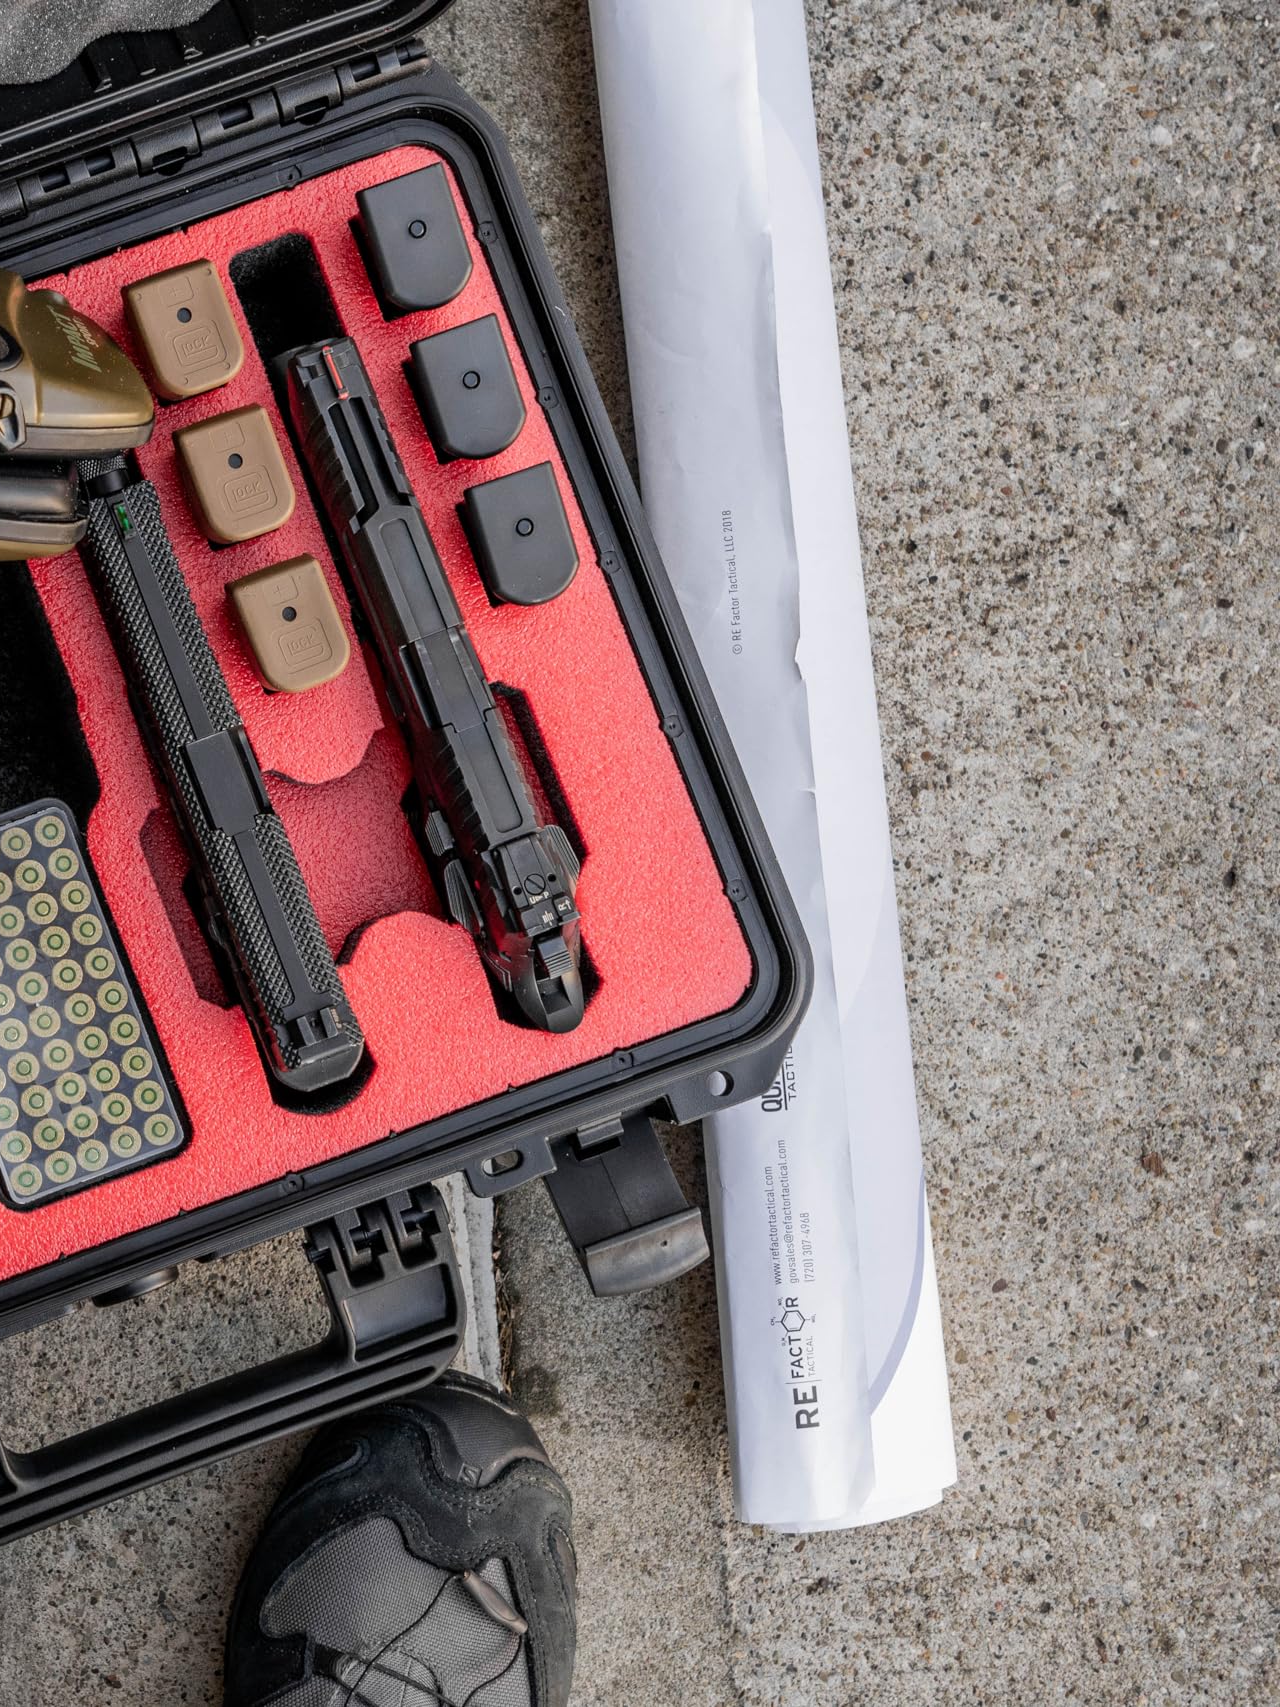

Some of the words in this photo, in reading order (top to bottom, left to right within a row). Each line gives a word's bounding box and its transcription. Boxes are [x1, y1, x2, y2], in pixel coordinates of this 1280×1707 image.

[46, 304, 102, 373] IMPACT
[721, 510, 733, 533] 2018
[723, 535, 735, 552] LLC
[725, 554, 738, 594] Tactical,
[730, 597, 741, 626] Factor
[731, 628, 742, 641] RE
[763, 1166, 783, 1286] www.refactortactical.com
[777, 1139, 799, 1284] govsales@refactortactical.com
[799, 1212, 813, 1256] 307-4968
[802, 1258, 816, 1283] (720)
[806, 1335, 816, 1377] TACTICAL
[792, 1385, 820, 1430] RE
